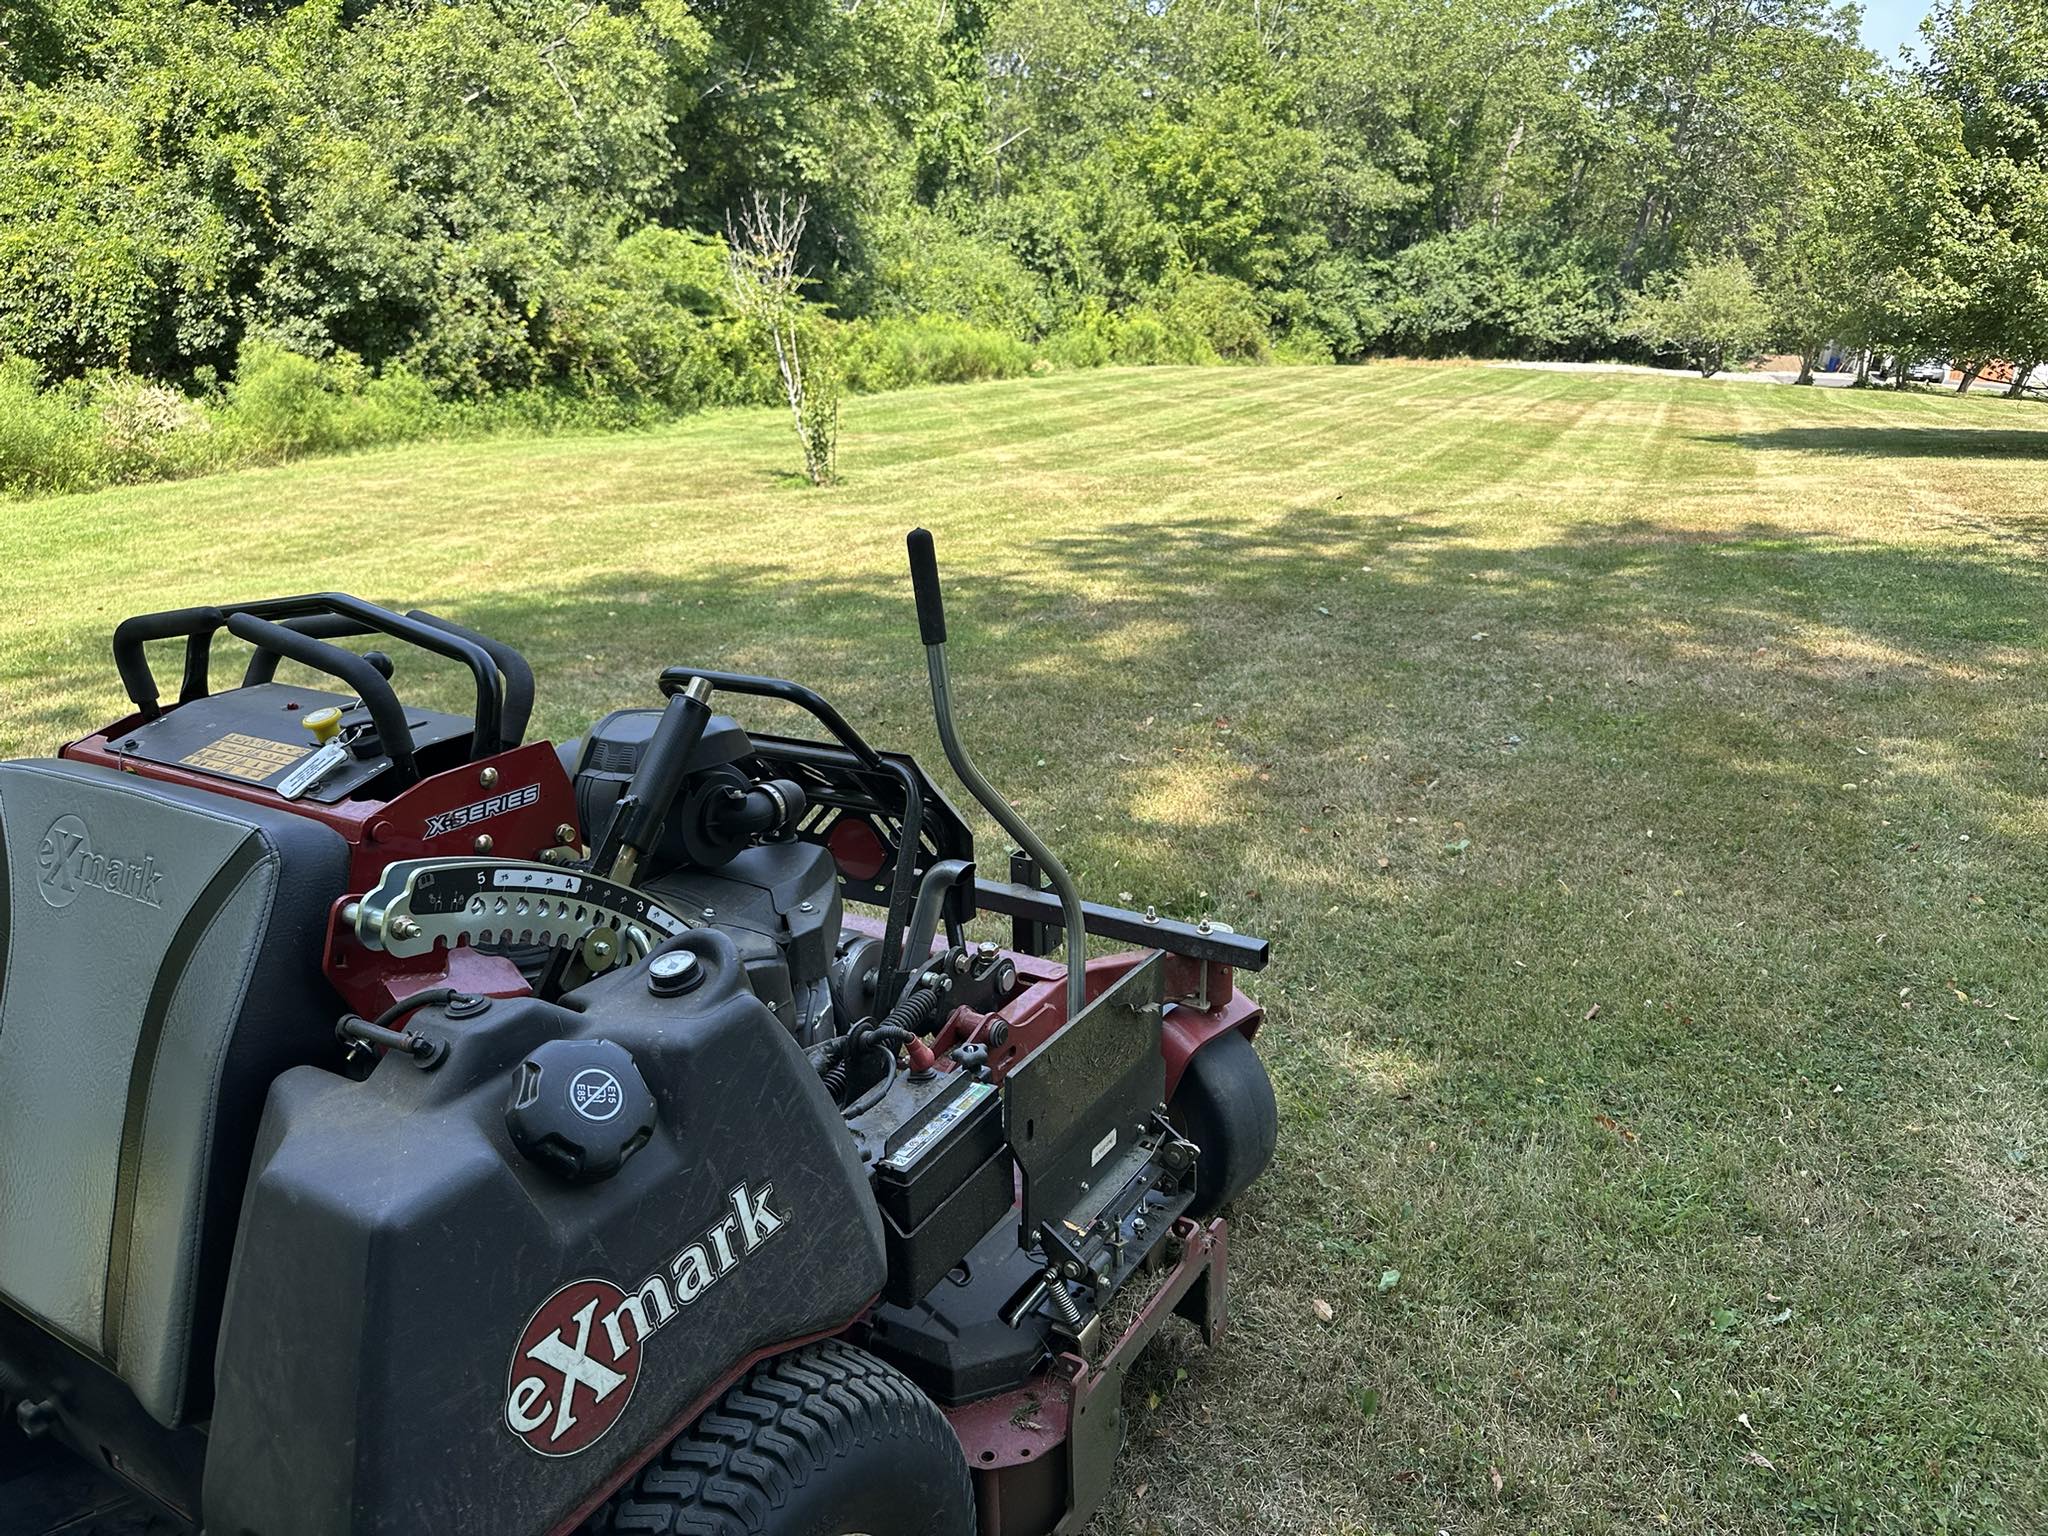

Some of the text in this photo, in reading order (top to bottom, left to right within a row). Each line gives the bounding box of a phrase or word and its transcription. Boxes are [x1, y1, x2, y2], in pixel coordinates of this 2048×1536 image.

[425, 785, 539, 838] X-SERIES
[477, 871, 486, 885] 5
[565, 878, 573, 889] 4
[636, 900, 645, 913] 3
[576, 1083, 587, 1103] E85
[607, 1085, 617, 1104] E15
[506, 1180, 785, 1442] eXmark
